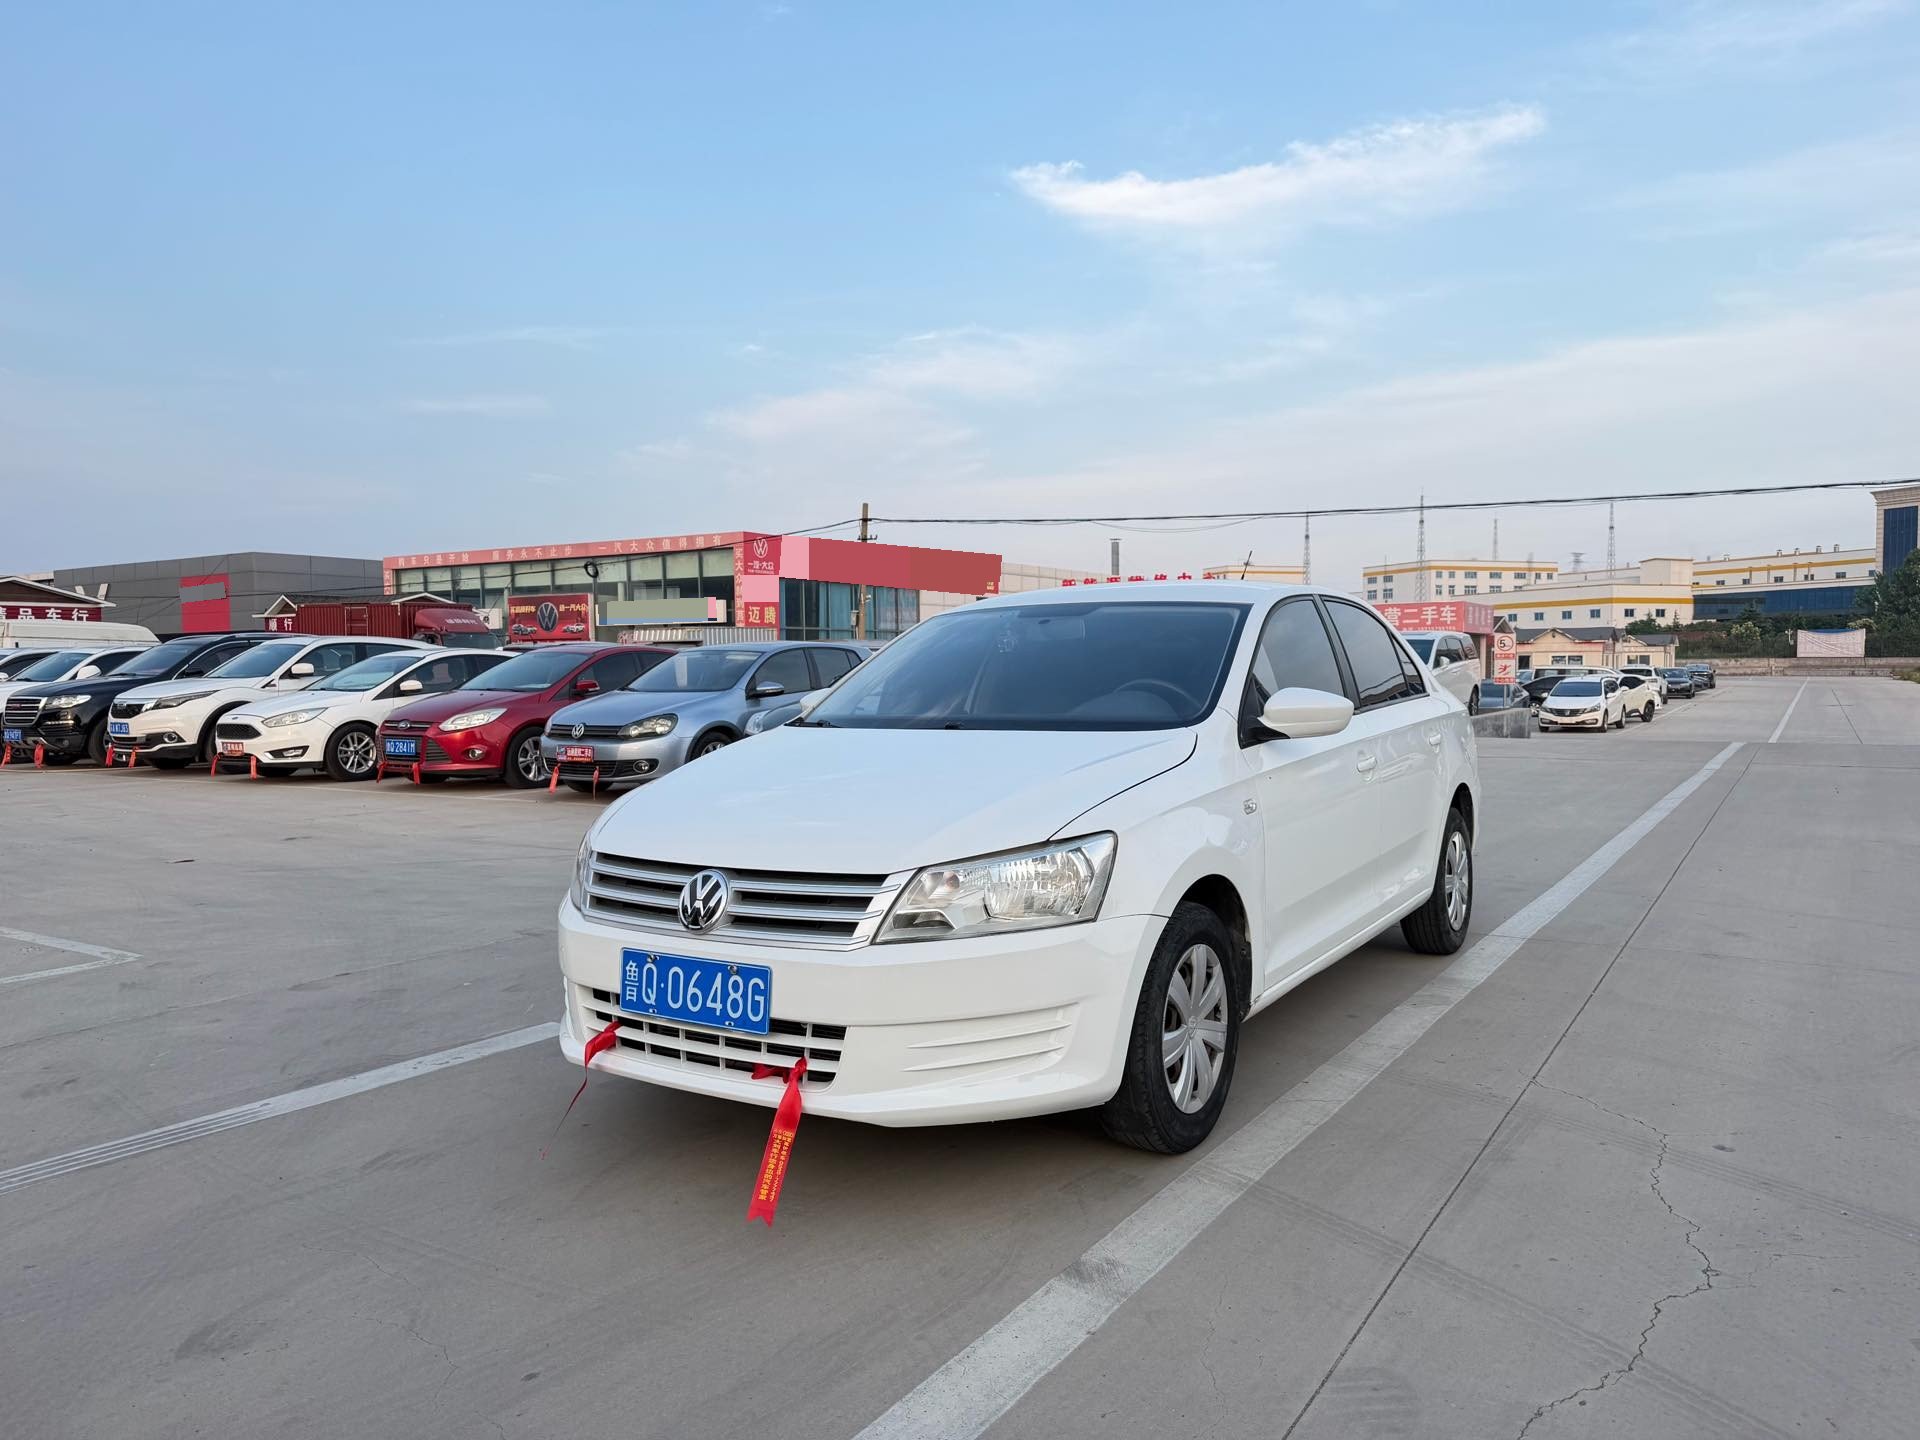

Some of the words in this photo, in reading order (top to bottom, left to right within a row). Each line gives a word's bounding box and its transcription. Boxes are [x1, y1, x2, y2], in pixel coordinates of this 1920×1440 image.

[748, 606, 776, 624] 迈腾
[1382, 605, 1457, 626] 营二手车
